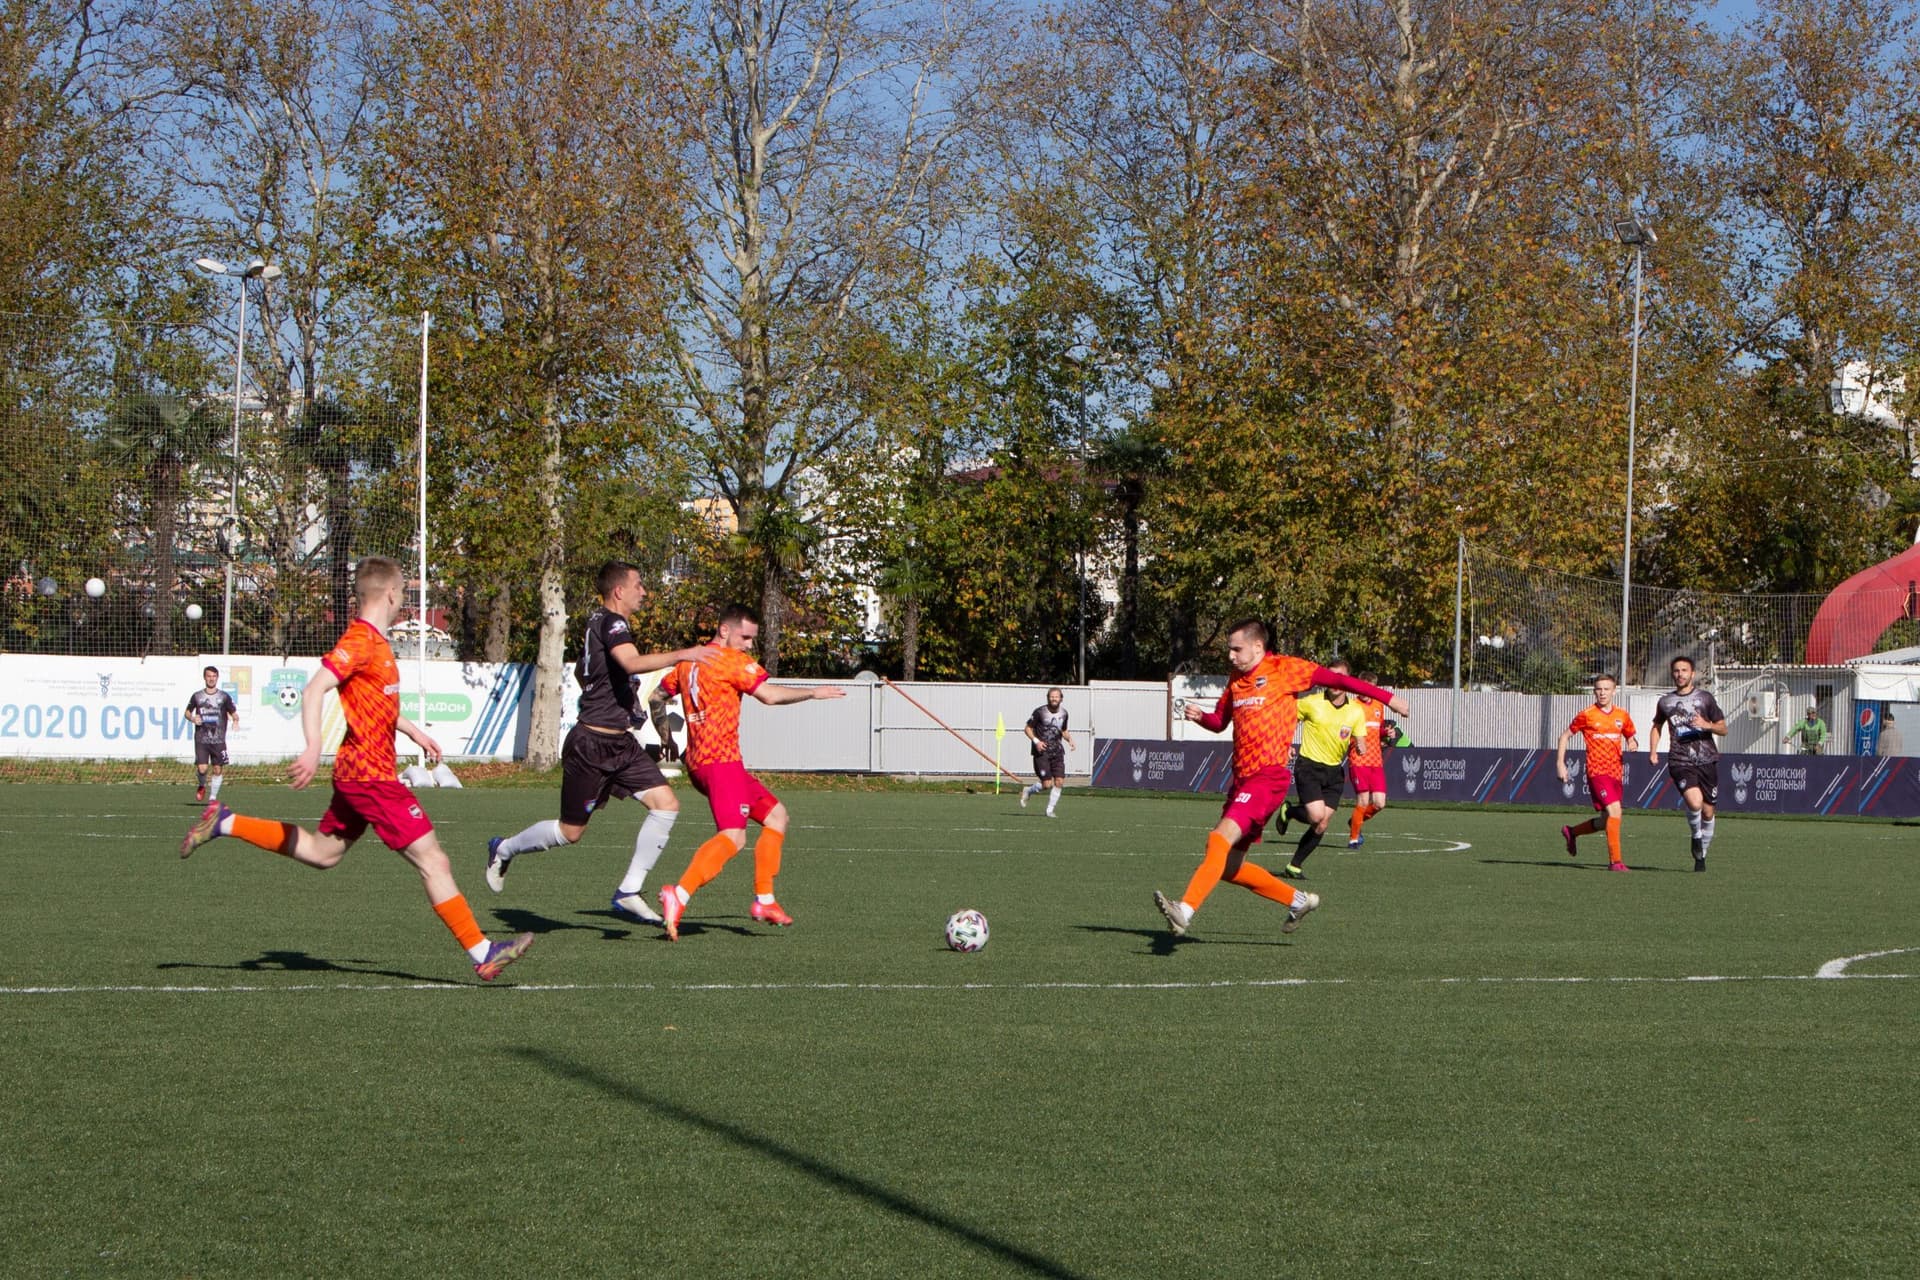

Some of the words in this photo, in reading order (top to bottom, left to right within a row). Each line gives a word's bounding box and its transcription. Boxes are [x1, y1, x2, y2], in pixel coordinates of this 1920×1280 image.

[400, 701, 466, 712] МЕАФОН
[1, 703, 87, 739] 2020
[100, 704, 193, 740] СОЧИ
[1423, 758, 1466, 770] РОССИЙСКИЙ
[1423, 769, 1466, 780] ФУТБОЛЬНЫЙ
[1756, 767, 1807, 780] РОССИЙСКИЙ
[1423, 780, 1441, 790] СОЮЗ
[1755, 778, 1806, 791] ФУТБОЛЬНЫЙ
[1755, 790, 1777, 801] СОЮЗ
